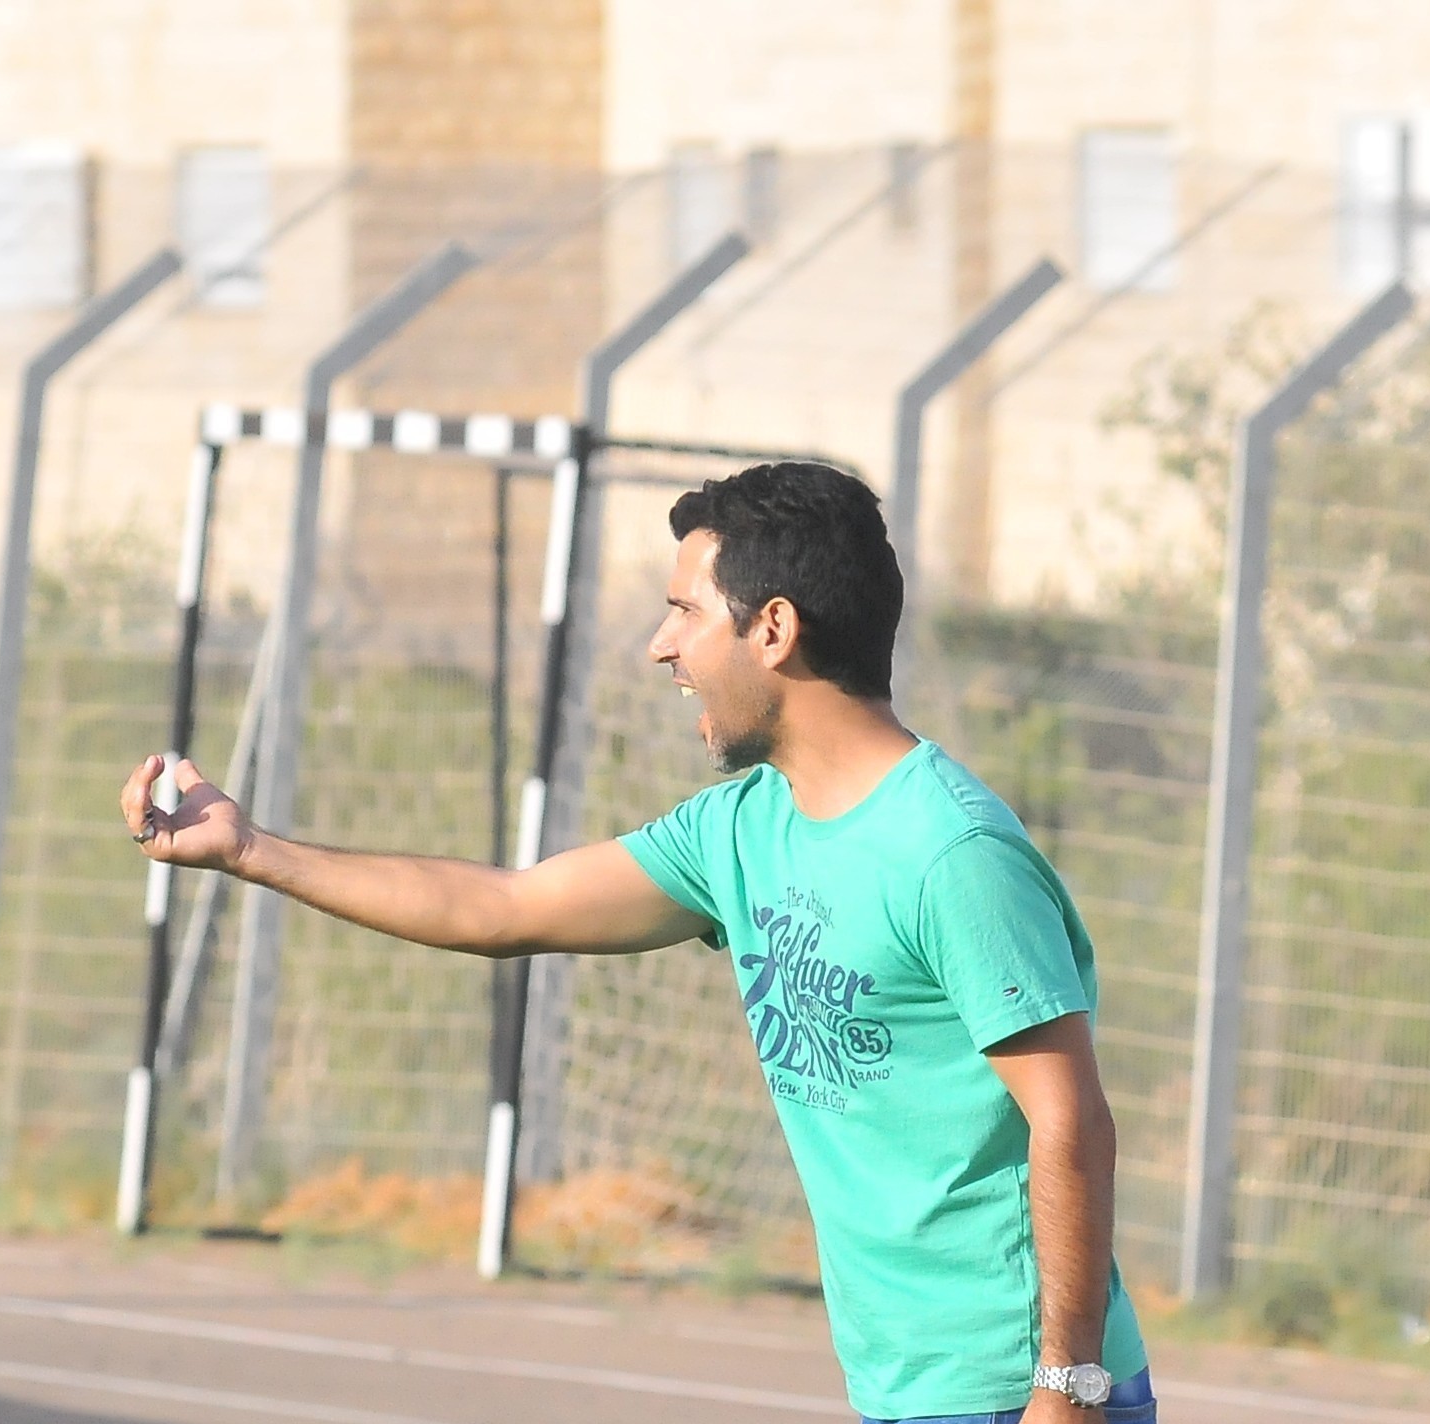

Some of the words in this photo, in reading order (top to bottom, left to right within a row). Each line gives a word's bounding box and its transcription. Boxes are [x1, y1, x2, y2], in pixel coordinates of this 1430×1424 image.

[847, 1026, 884, 1054] 85
[769, 1072, 801, 1096] New
[806, 1084, 828, 1106] York
